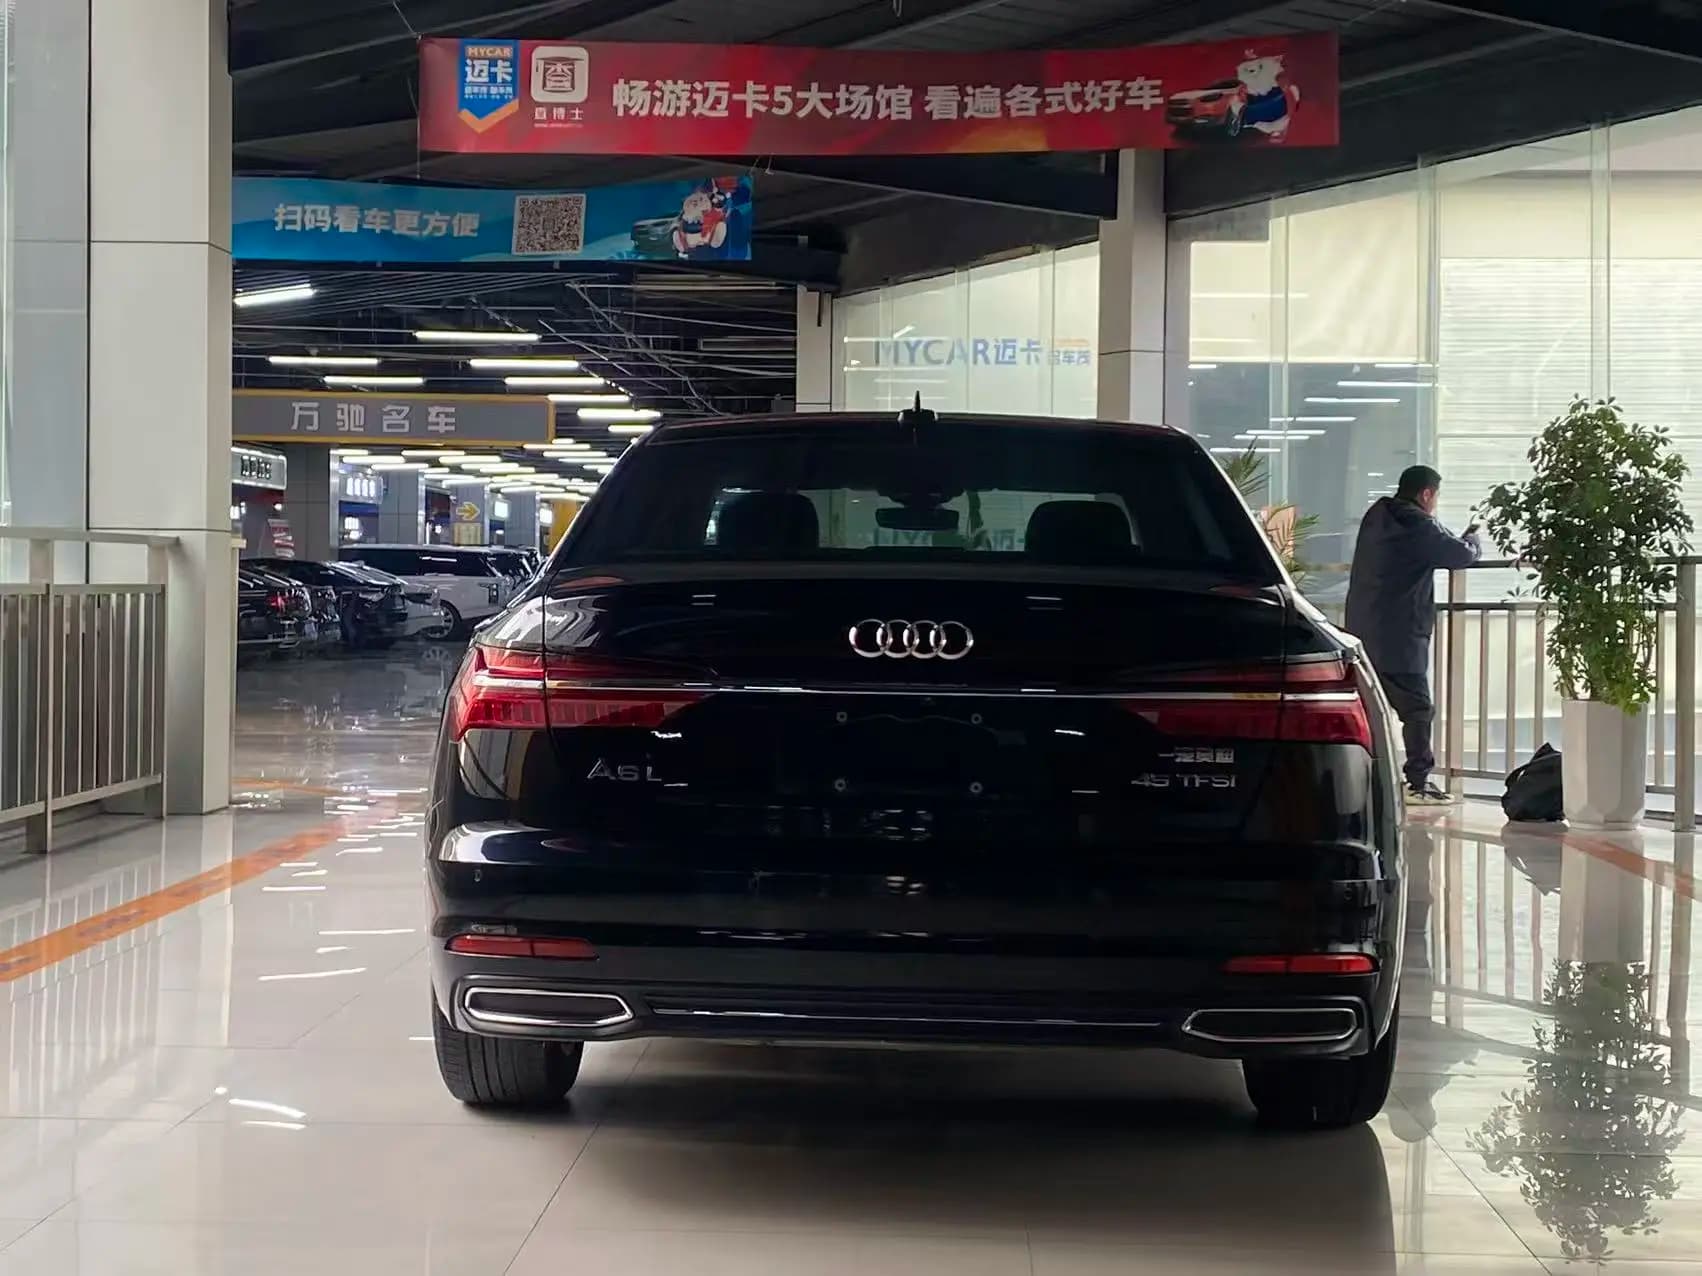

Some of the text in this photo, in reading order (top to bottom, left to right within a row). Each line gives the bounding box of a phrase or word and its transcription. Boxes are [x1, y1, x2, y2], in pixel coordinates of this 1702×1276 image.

[466, 47, 513, 58] MYCAR
[465, 59, 513, 83] 迈卡
[612, 76, 1164, 121] 畅游迈卡5大场馆 看遍各式好车
[274, 203, 480, 237] 扫码看车更方便
[290, 402, 456, 432] 万驰名车
[1130, 773, 1236, 788] 45 TFSI
